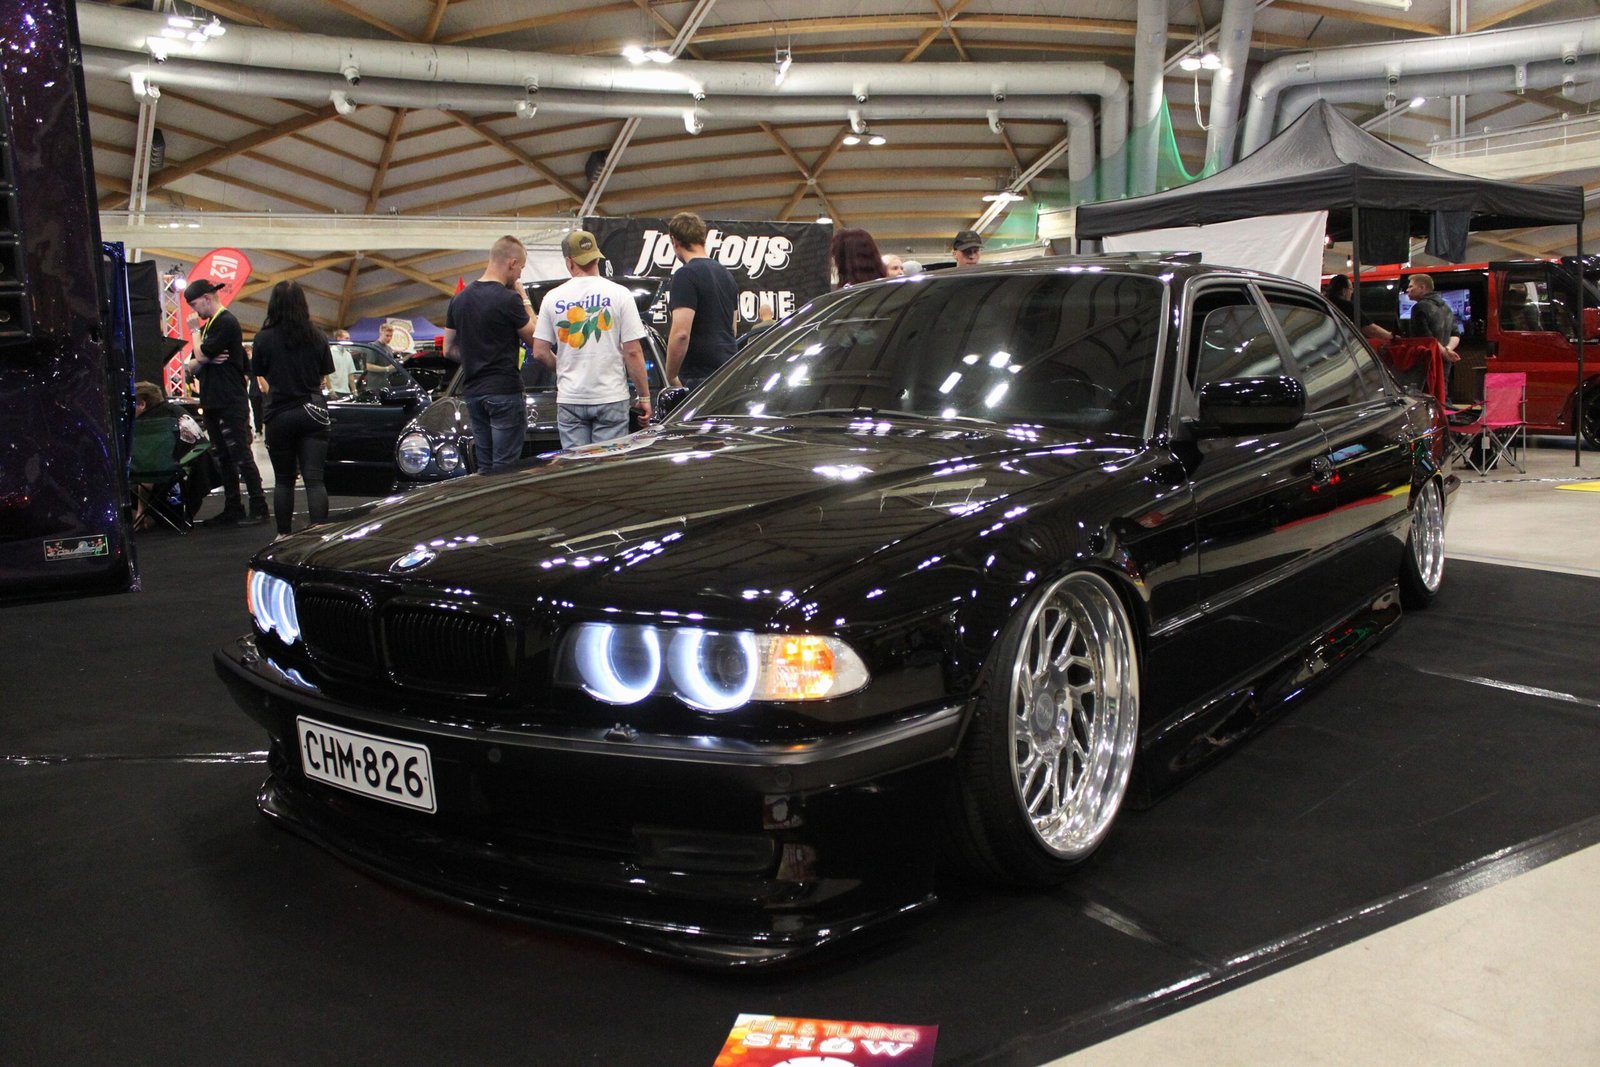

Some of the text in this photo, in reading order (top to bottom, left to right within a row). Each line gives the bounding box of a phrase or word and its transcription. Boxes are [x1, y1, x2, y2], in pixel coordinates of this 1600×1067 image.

[633, 229, 793, 279] Jatoys
[555, 294, 611, 315] Sevilla
[305, 730, 424, 798] CHM-826
[742, 1032, 914, 1057] SHOW
